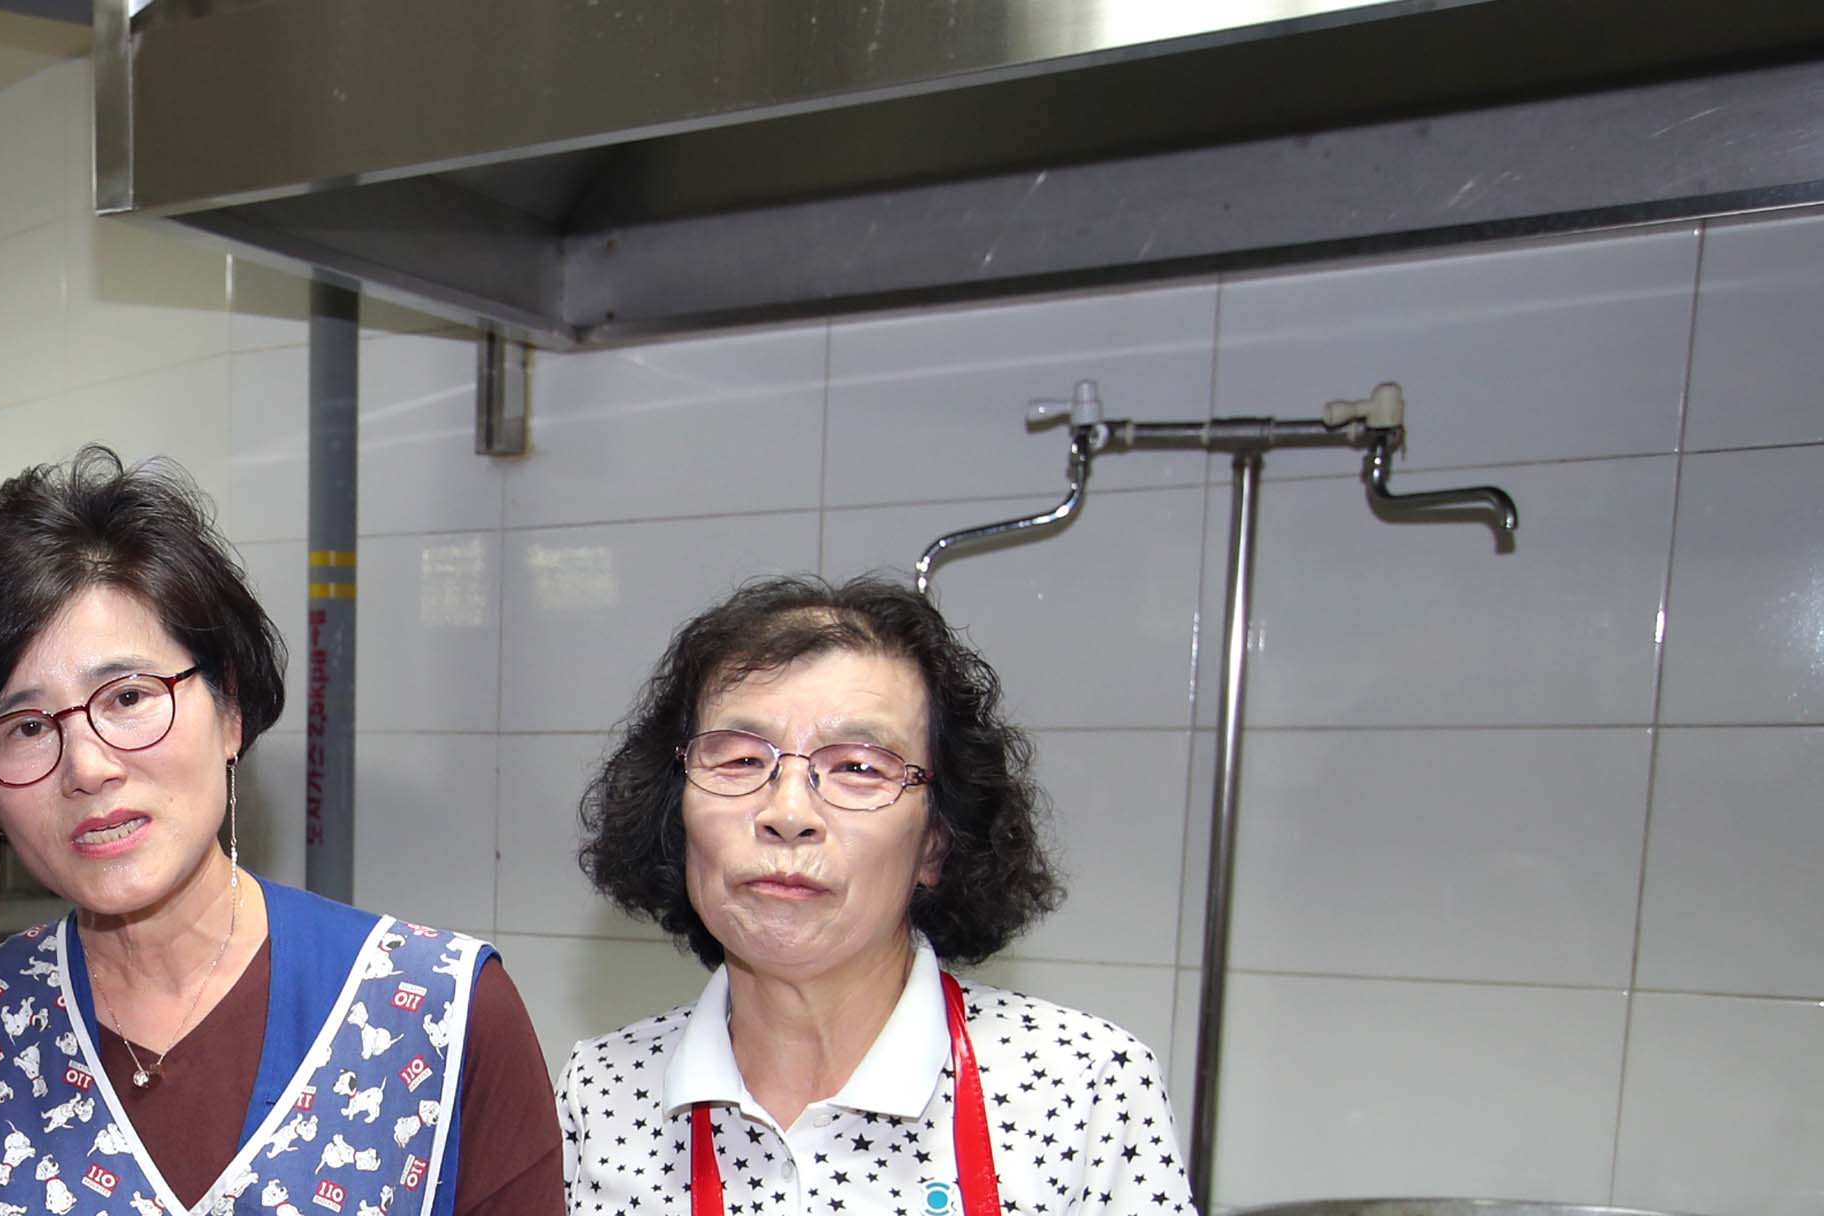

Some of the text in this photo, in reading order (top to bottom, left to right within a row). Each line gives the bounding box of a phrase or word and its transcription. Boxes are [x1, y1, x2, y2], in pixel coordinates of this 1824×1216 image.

[394, 993, 420, 1009] 110
[66, 1068, 92, 1088] 110
[402, 1059, 424, 1084] 110
[87, 1166, 116, 1188] 110
[407, 1159, 427, 1188] 110
[318, 1182, 344, 1199] 110
